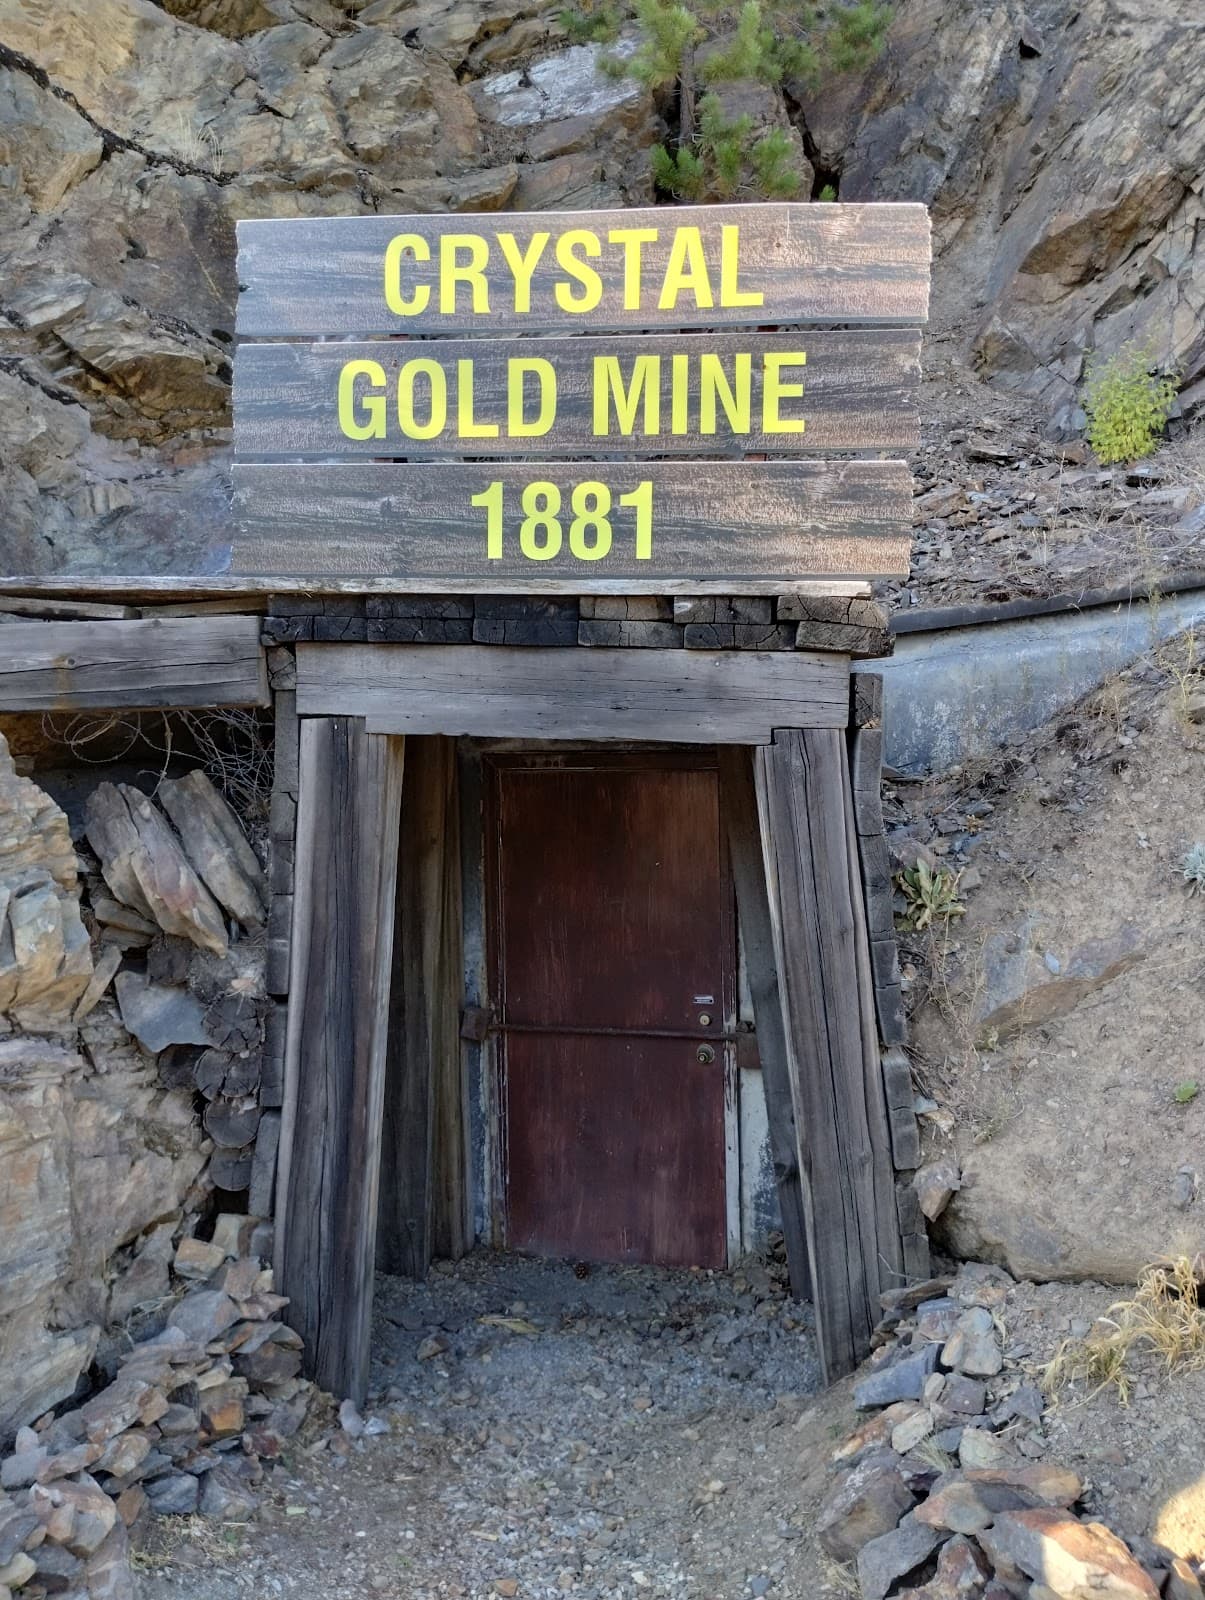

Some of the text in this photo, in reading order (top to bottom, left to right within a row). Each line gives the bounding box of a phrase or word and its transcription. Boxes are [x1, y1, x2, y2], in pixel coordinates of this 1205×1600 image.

[384, 225, 764, 316] CRYSTAL
[337, 352, 807, 440] GOLD MINE
[471, 481, 654, 561] 1881
